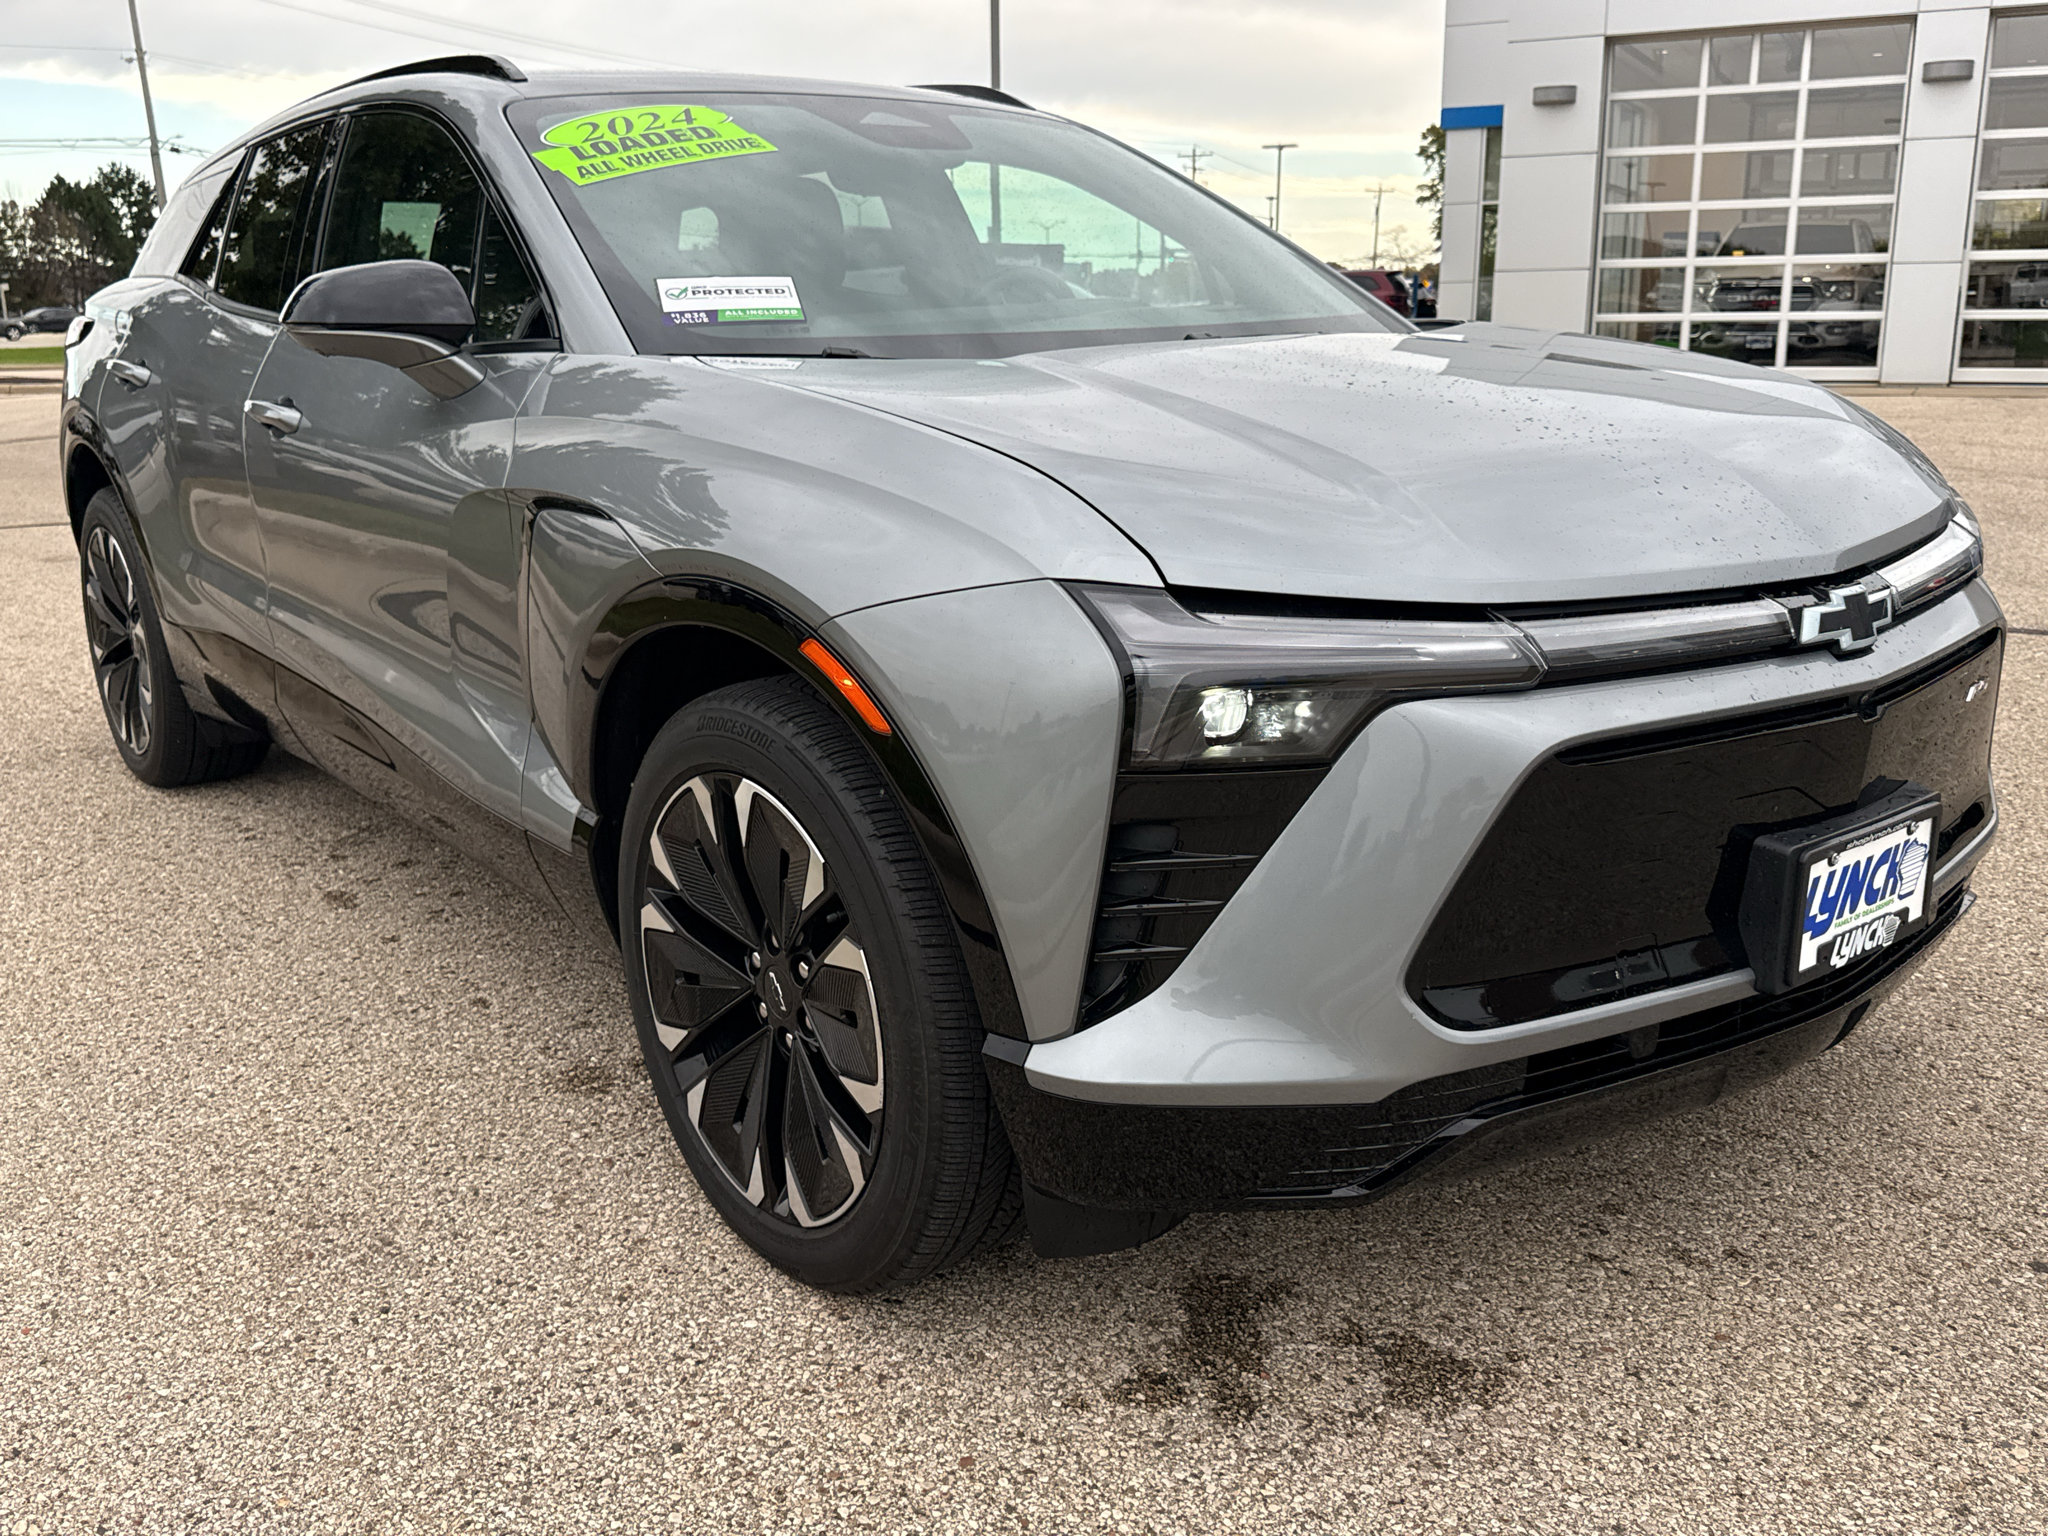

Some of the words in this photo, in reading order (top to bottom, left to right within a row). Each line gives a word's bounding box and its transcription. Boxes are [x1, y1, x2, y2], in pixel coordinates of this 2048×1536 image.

[569, 126, 721, 161] LOADED
[576, 107, 697, 144] 2024
[576, 159, 621, 179] ALL
[619, 146, 697, 168] WHEEL
[699, 137, 763, 155] DRIVE
[691, 288, 786, 296] PROTECTED
[696, 715, 777, 753] BRIDGESTONE
[1803, 838, 1910, 940] LYNCH
[1835, 916, 1853, 928] FAMILY
[1830, 914, 1886, 968] LYNCH
